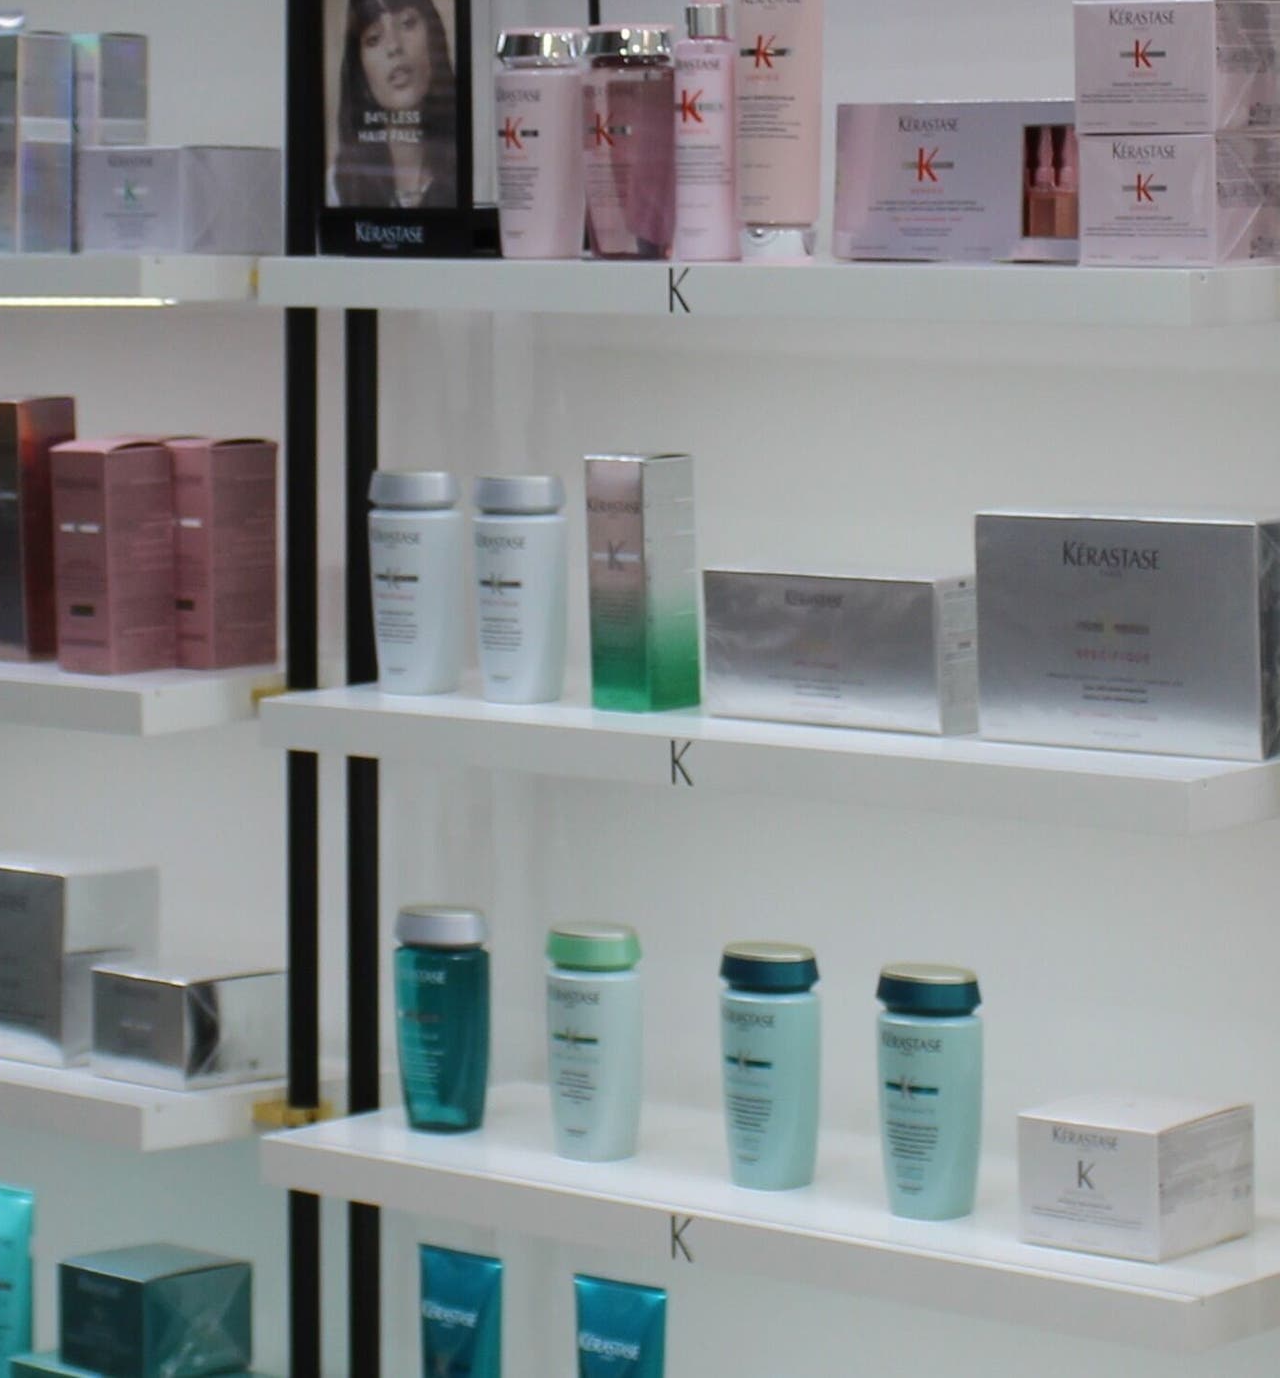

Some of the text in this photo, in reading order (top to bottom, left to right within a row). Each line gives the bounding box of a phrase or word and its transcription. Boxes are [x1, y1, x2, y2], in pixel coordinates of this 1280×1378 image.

[1108, 8, 1175, 27] KÉRASTASE
[754, 34, 777, 69] K
[1134, 38, 1153, 69] K
[391, 109, 421, 125] LESS
[681, 88, 704, 124] K
[358, 128, 388, 143] HAIR
[504, 116, 523, 150] K
[898, 116, 960, 133] KÉRASTASE
[917, 146, 940, 183] K
[1111, 141, 1177, 161] KÉRASTASE
[1136, 173, 1155, 203] K
[354, 221, 424, 244] KÉRASTASE
[668, 266, 691, 314] K
[1061, 539, 1161, 571] KÉRASTASE
[671, 739, 694, 787] K
[1051, 1125, 1120, 1151] KÉRASTASE
[1076, 1159, 1096, 1191] K
[670, 1214, 694, 1263] K
